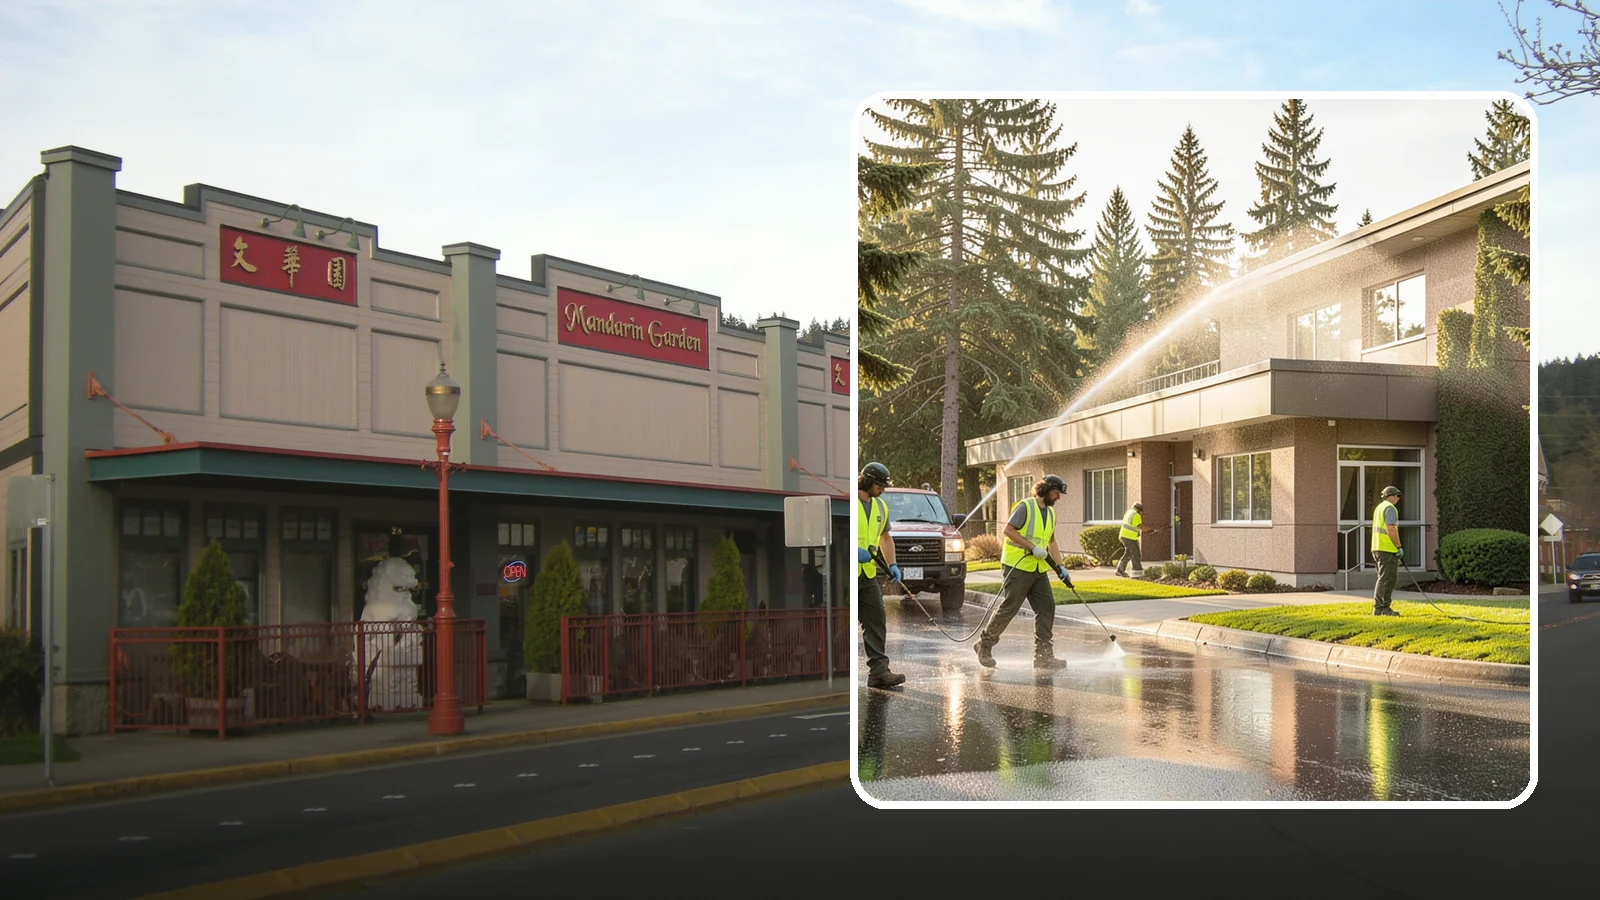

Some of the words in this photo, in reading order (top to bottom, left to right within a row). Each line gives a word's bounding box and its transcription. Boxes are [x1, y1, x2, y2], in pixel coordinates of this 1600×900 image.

[230, 235, 347, 291] 文華園
[564, 302, 644, 341] Mandarin
[648, 320, 702, 352] Garden
[503, 565, 528, 579] OPEN
